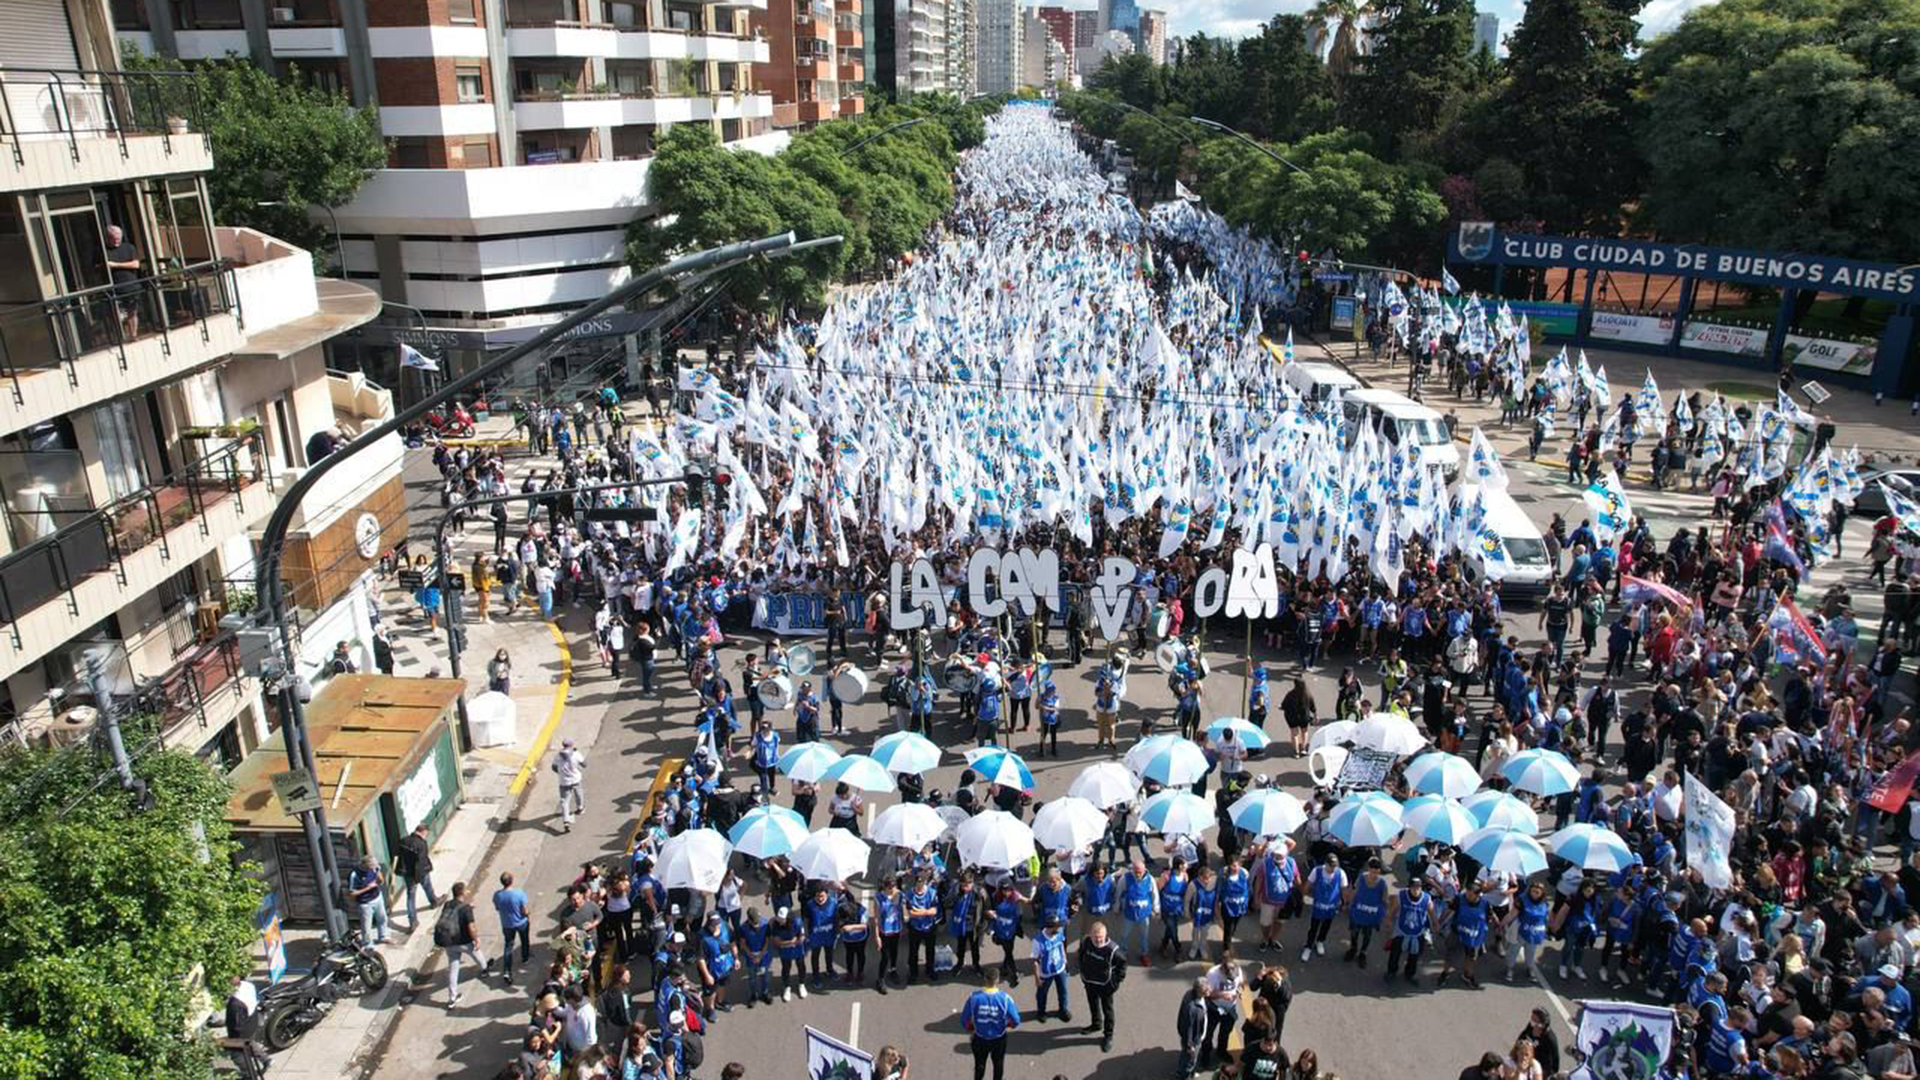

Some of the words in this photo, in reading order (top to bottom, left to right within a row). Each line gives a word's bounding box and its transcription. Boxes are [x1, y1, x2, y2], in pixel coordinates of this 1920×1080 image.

[1504, 241, 1563, 259] CLUB
[1574, 245, 1665, 266] CIUDAD
[1676, 251, 1707, 270] DE
[1718, 255, 1824, 282] BUENOS
[1831, 267, 1915, 294] AIRES
[1809, 343, 1839, 357] GOLF
[891, 557, 947, 629] LA
